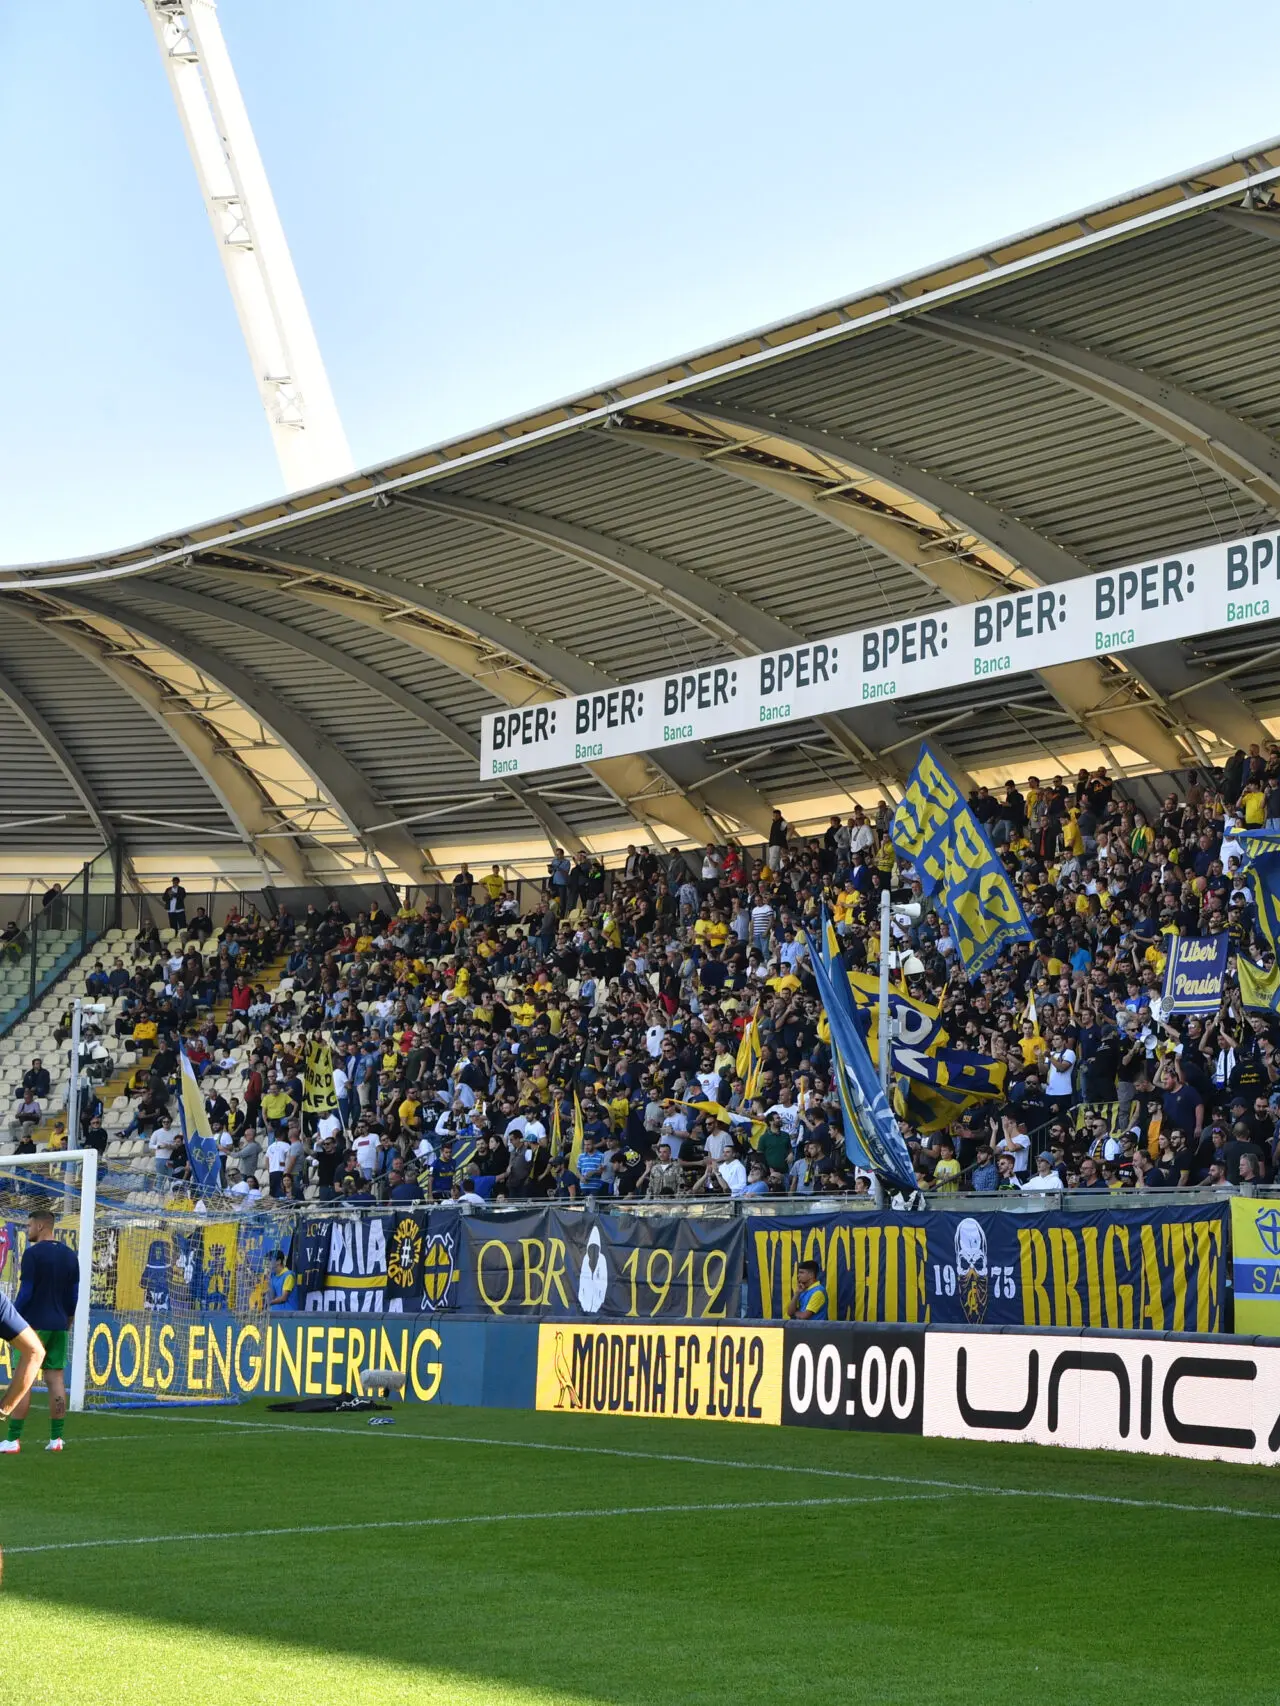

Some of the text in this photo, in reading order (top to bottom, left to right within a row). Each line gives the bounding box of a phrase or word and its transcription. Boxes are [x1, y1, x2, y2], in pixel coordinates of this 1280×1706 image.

[1095, 560, 1195, 621] BPER:
[974, 590, 1066, 648] BPER:
[1227, 599, 1270, 623] Banca
[862, 618, 948, 673] BPER:
[1095, 628, 1136, 650] Banca
[760, 644, 838, 696] BPER:
[974, 654, 1011, 677] Banca
[663, 667, 737, 717] BPER:
[862, 679, 897, 701] Banca
[492, 707, 557, 751] BPER:
[575, 688, 644, 735] BPER:
[759, 703, 791, 722] Banca
[575, 741, 603, 759] Banca
[663, 723, 693, 742] Banca
[492, 757, 518, 774] Banca
[1179, 939, 1217, 962] Liberi
[933, 1264, 956, 1297] 19
[990, 1266, 1016, 1299] 75
[88, 1322, 176, 1390] OOLS
[571, 1332, 764, 1418] MODENA FC 1912
[788, 1343, 916, 1420] 00:00
